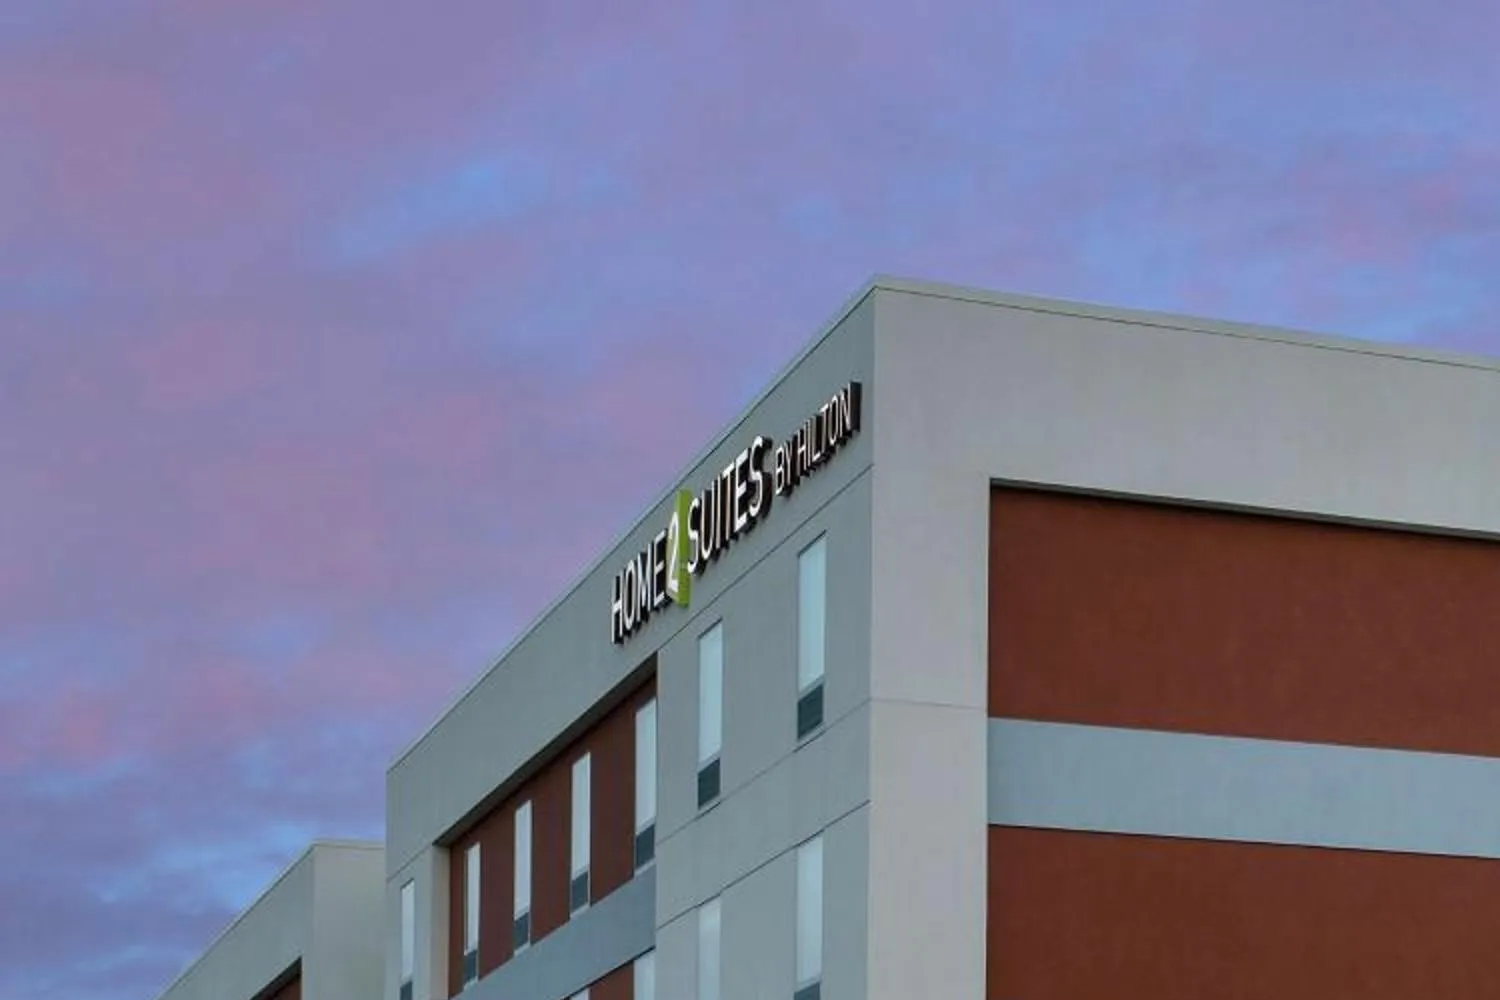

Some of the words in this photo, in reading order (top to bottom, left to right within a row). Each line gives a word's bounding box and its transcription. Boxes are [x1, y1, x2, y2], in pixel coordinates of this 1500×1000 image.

[687, 434, 770, 575] SUITES
[775, 440, 796, 496] BY
[796, 381, 856, 476] HILTON
